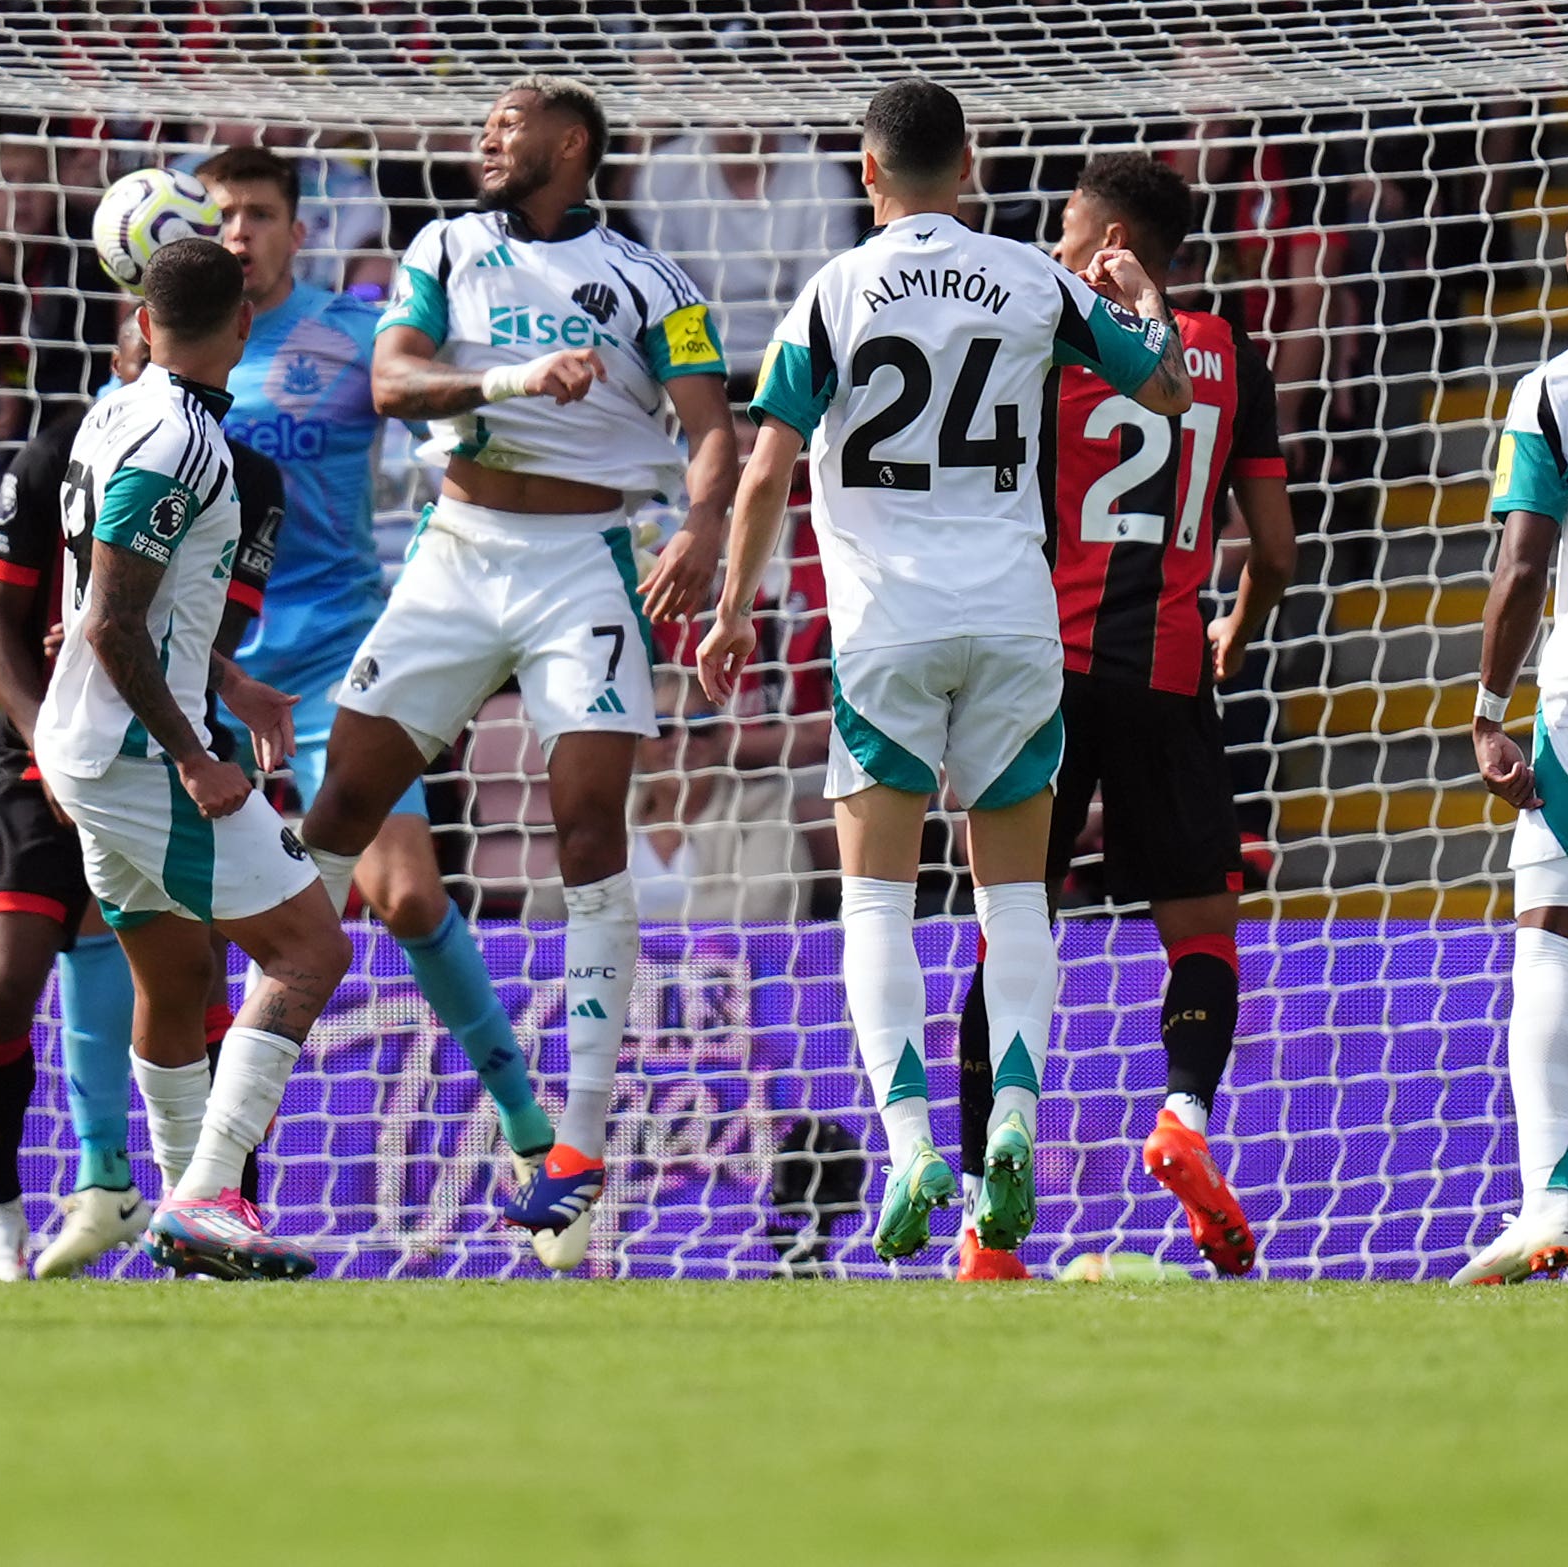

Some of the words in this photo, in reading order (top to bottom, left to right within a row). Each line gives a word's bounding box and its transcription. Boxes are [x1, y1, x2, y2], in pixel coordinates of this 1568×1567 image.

[863, 267, 1011, 315] ALMIRÓN
[842, 335, 1027, 493] 24
[1080, 395, 1221, 551] 21
[147, 538, 171, 556] room
[240, 548, 273, 574] LEO
[592, 626, 625, 682] 7
[568, 966, 617, 980] NUFC
